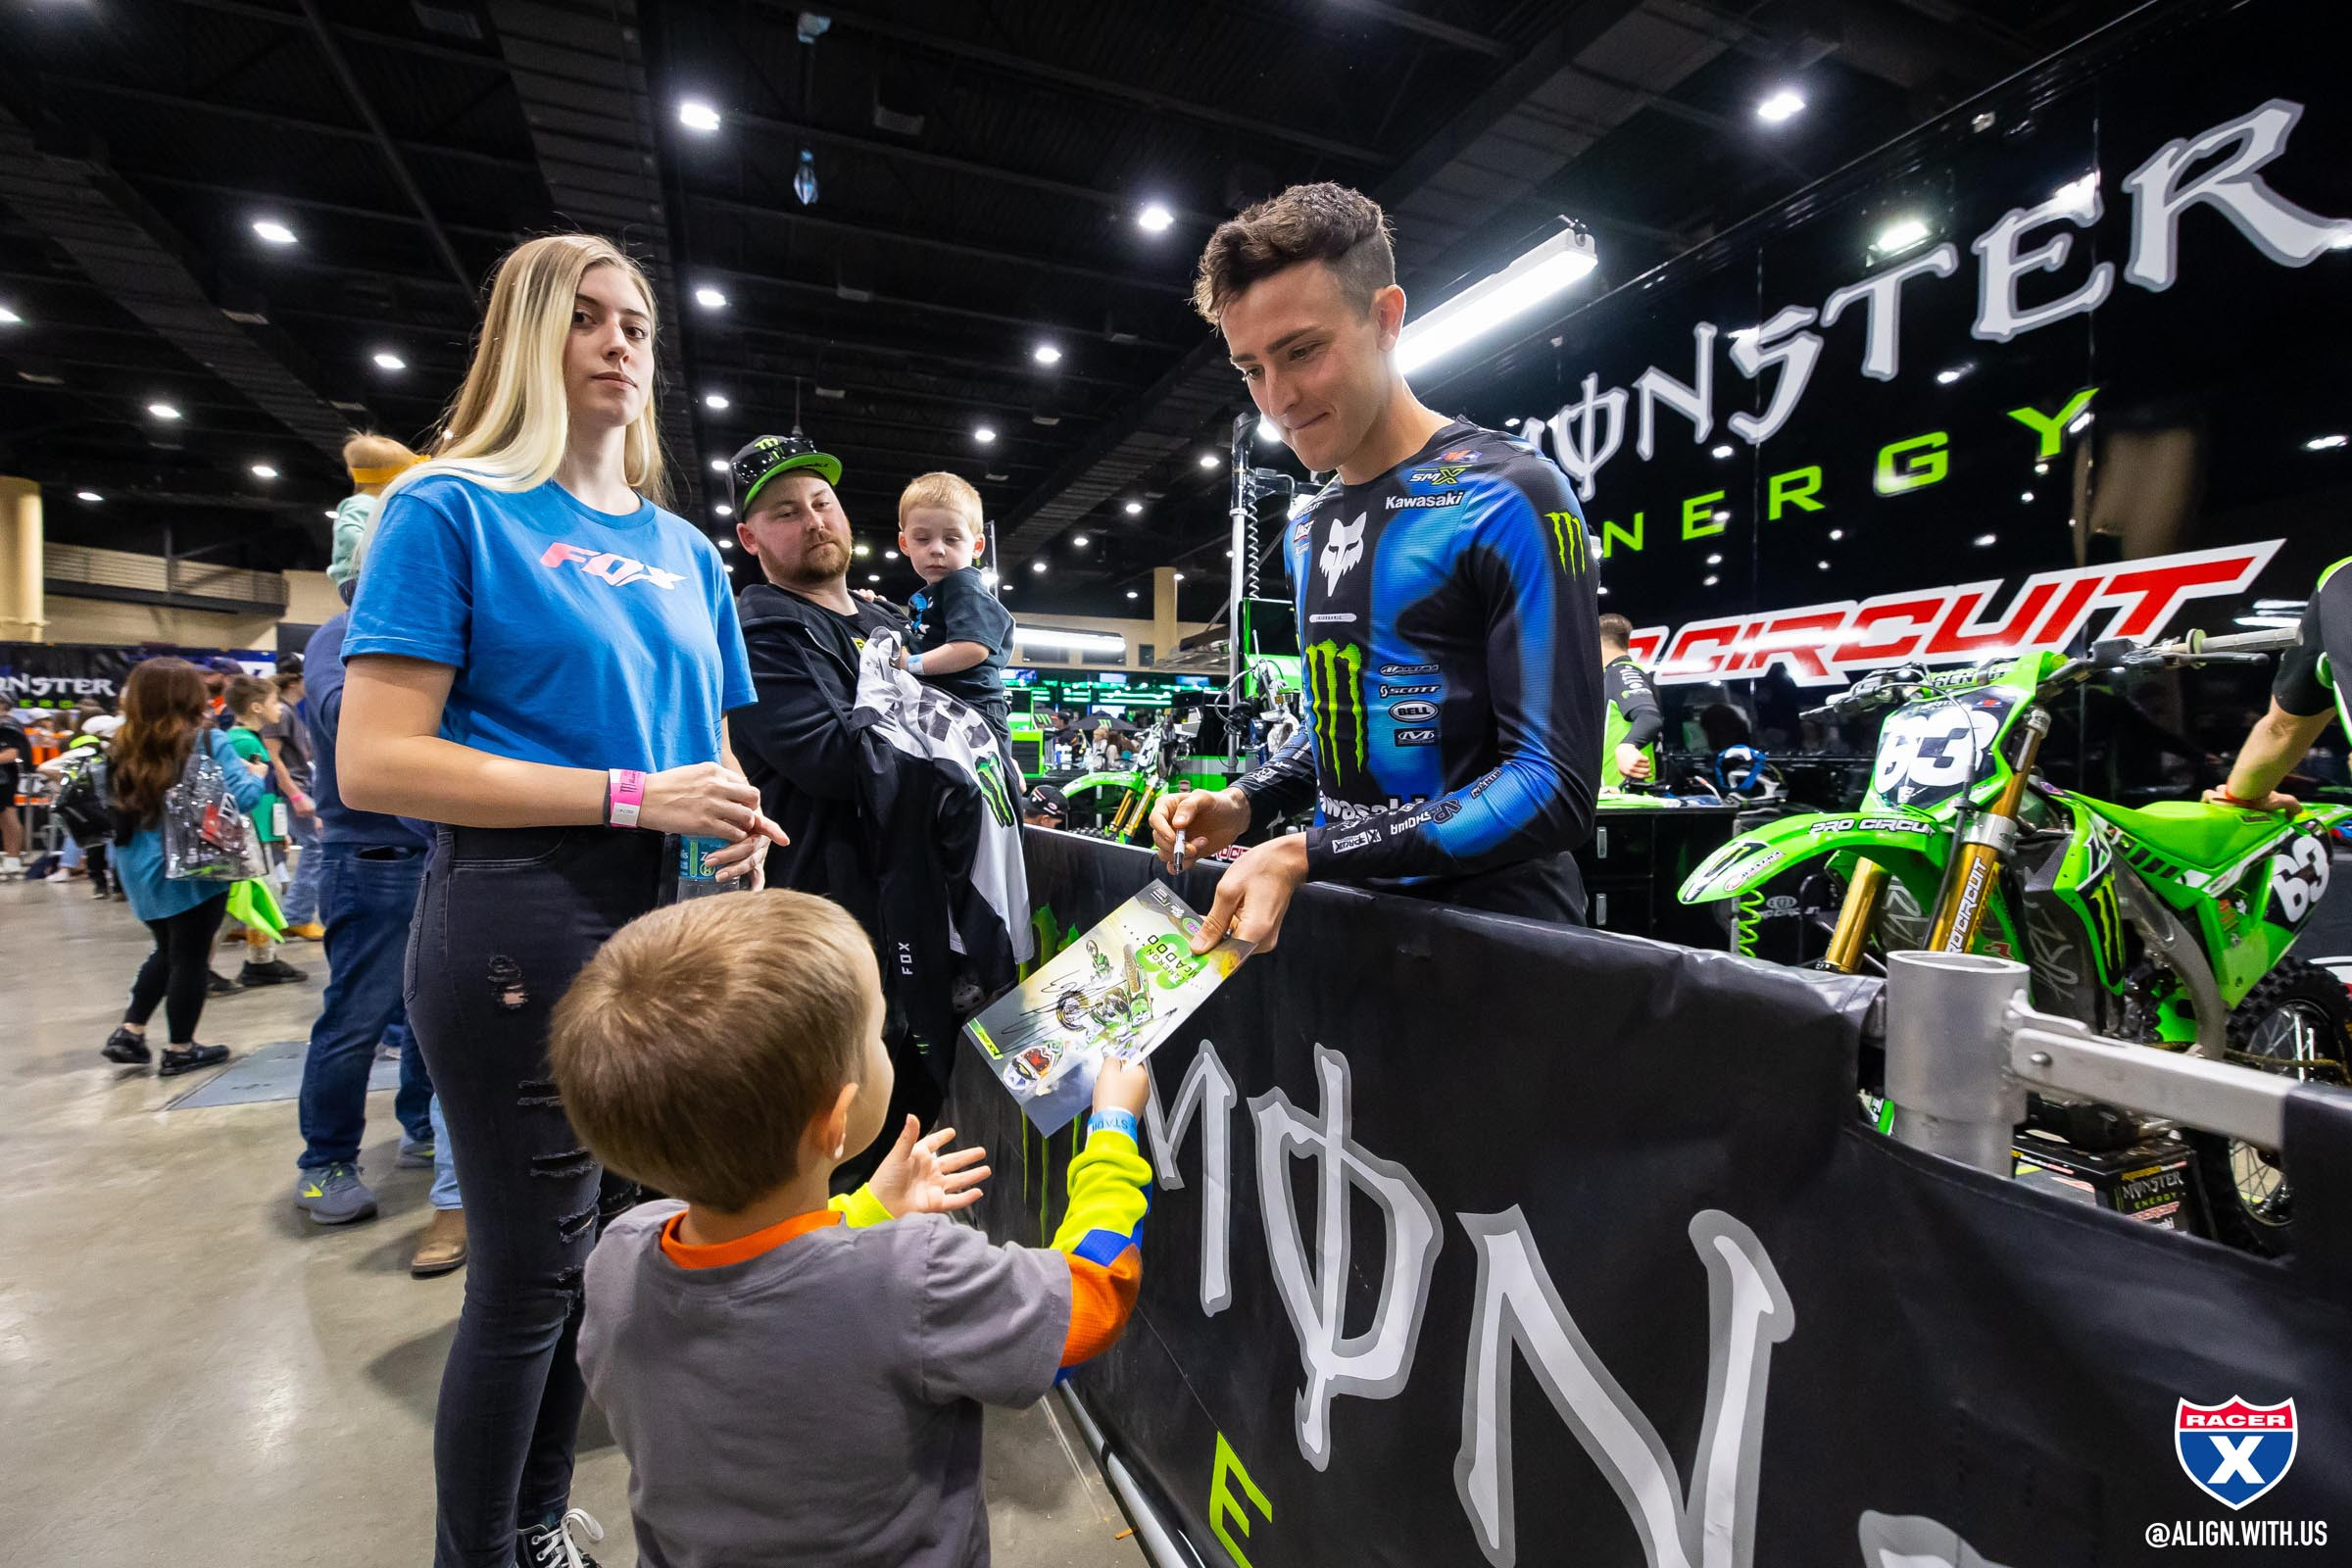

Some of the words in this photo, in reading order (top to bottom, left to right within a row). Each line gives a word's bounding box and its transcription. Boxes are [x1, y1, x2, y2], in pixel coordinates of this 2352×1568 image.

[1409, 466, 1470, 485] SMX
[1602, 388, 2099, 559] NERGY
[1385, 491, 1466, 511] Kawasaki
[540, 542, 687, 590] FOX
[1655, 539, 2285, 689] CIRCUIT
[1388, 685, 1440, 694] SCOTT
[1397, 707, 1431, 716] BELL
[1390, 810, 1432, 836] SHOWA
[1808, 818, 1855, 835] PRO
[1958, 857, 1989, 928] CIRCUIT
[2271, 835, 2331, 924] 63
[898, 942, 914, 975] FOX
[2122, 1170, 2185, 1201] MONSTER
[1143, 1039, 2014, 1568] MON
